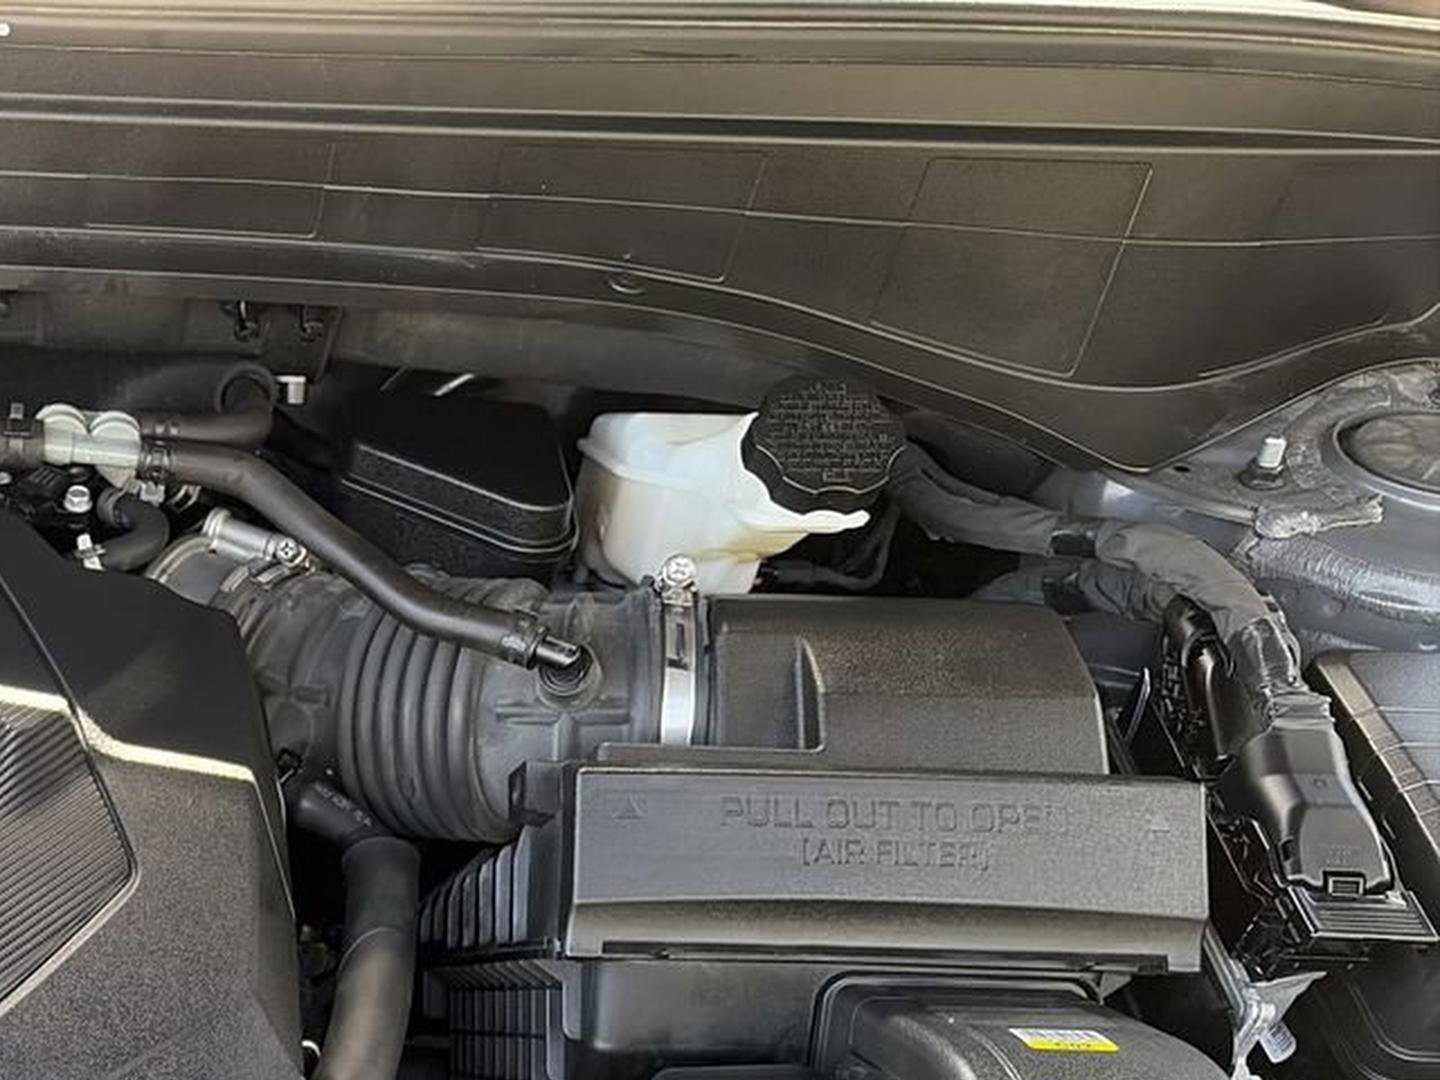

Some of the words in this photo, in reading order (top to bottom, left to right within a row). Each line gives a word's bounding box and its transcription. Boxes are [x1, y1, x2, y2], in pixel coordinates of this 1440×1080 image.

[720, 796, 814, 828] PULL
[825, 798, 901, 830] OUT
[911, 801, 958, 832] TO
